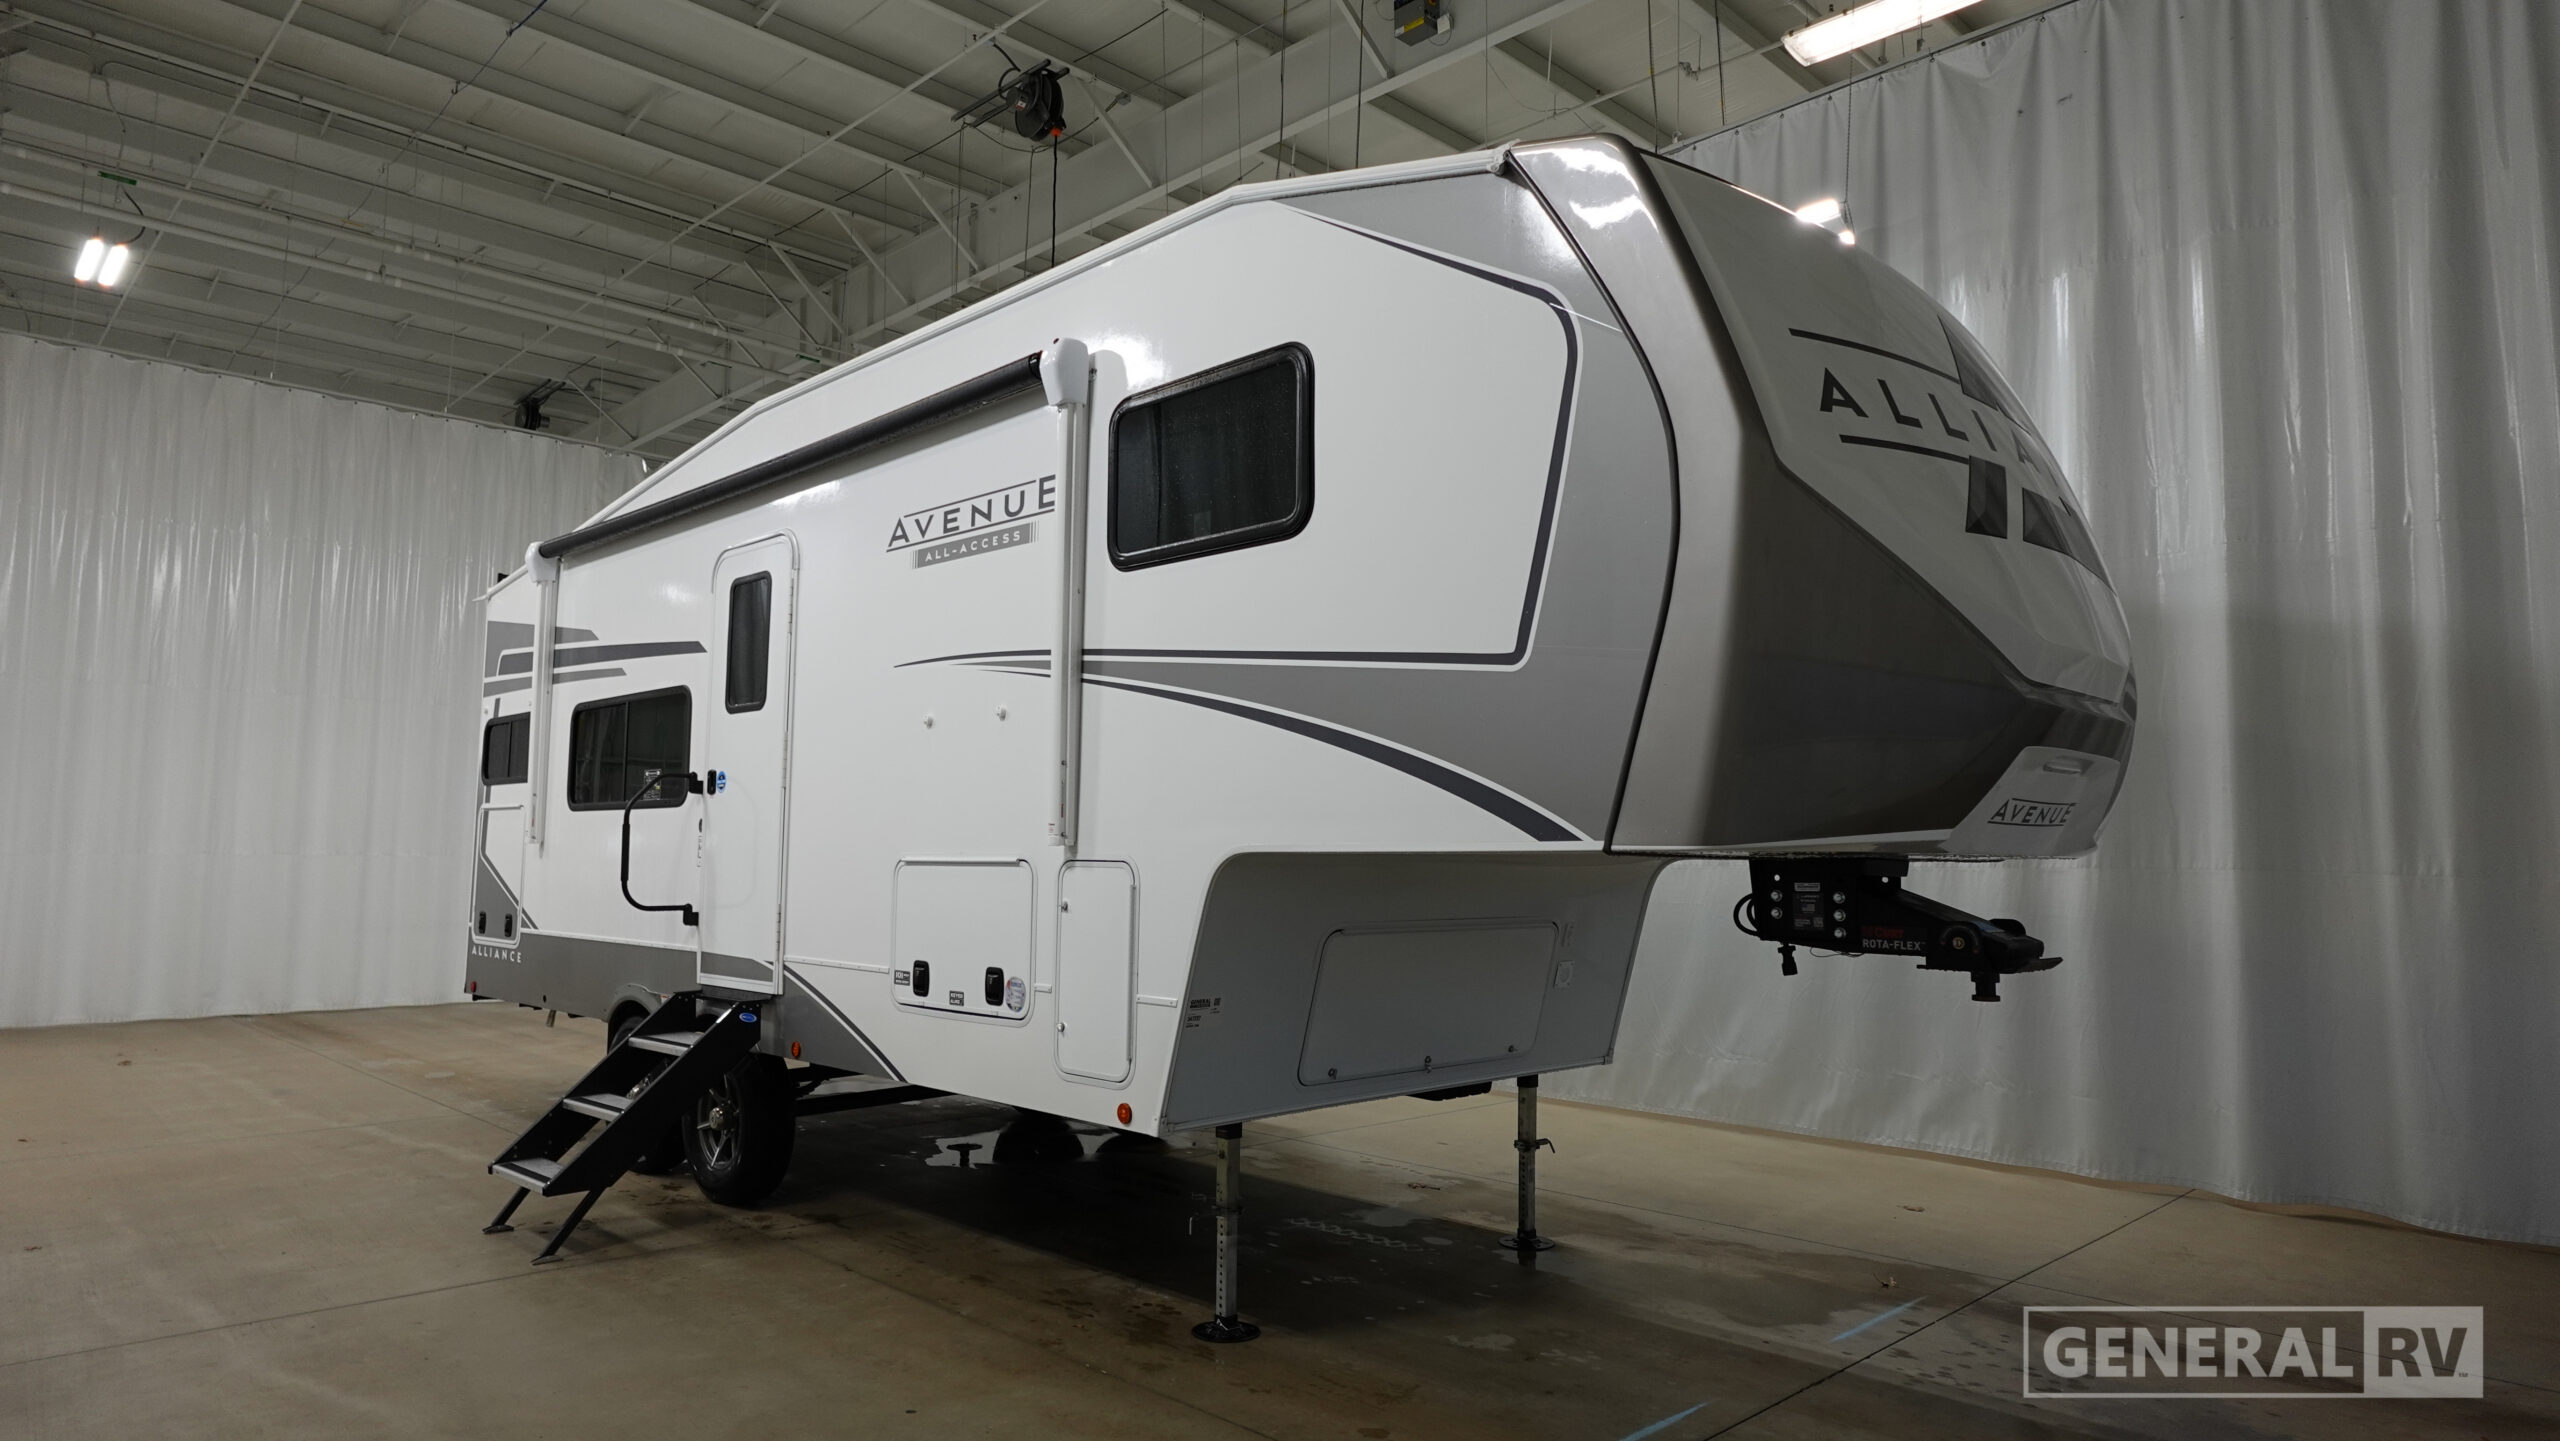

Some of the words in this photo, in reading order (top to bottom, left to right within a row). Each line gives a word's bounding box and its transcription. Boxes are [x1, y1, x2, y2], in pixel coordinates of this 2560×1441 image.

[887, 474, 1056, 548] AVENUE
[924, 530, 1022, 562] ALL-ACCESS
[1991, 799, 2077, 824] AVENUE
[471, 945, 523, 964] ALLIANCE
